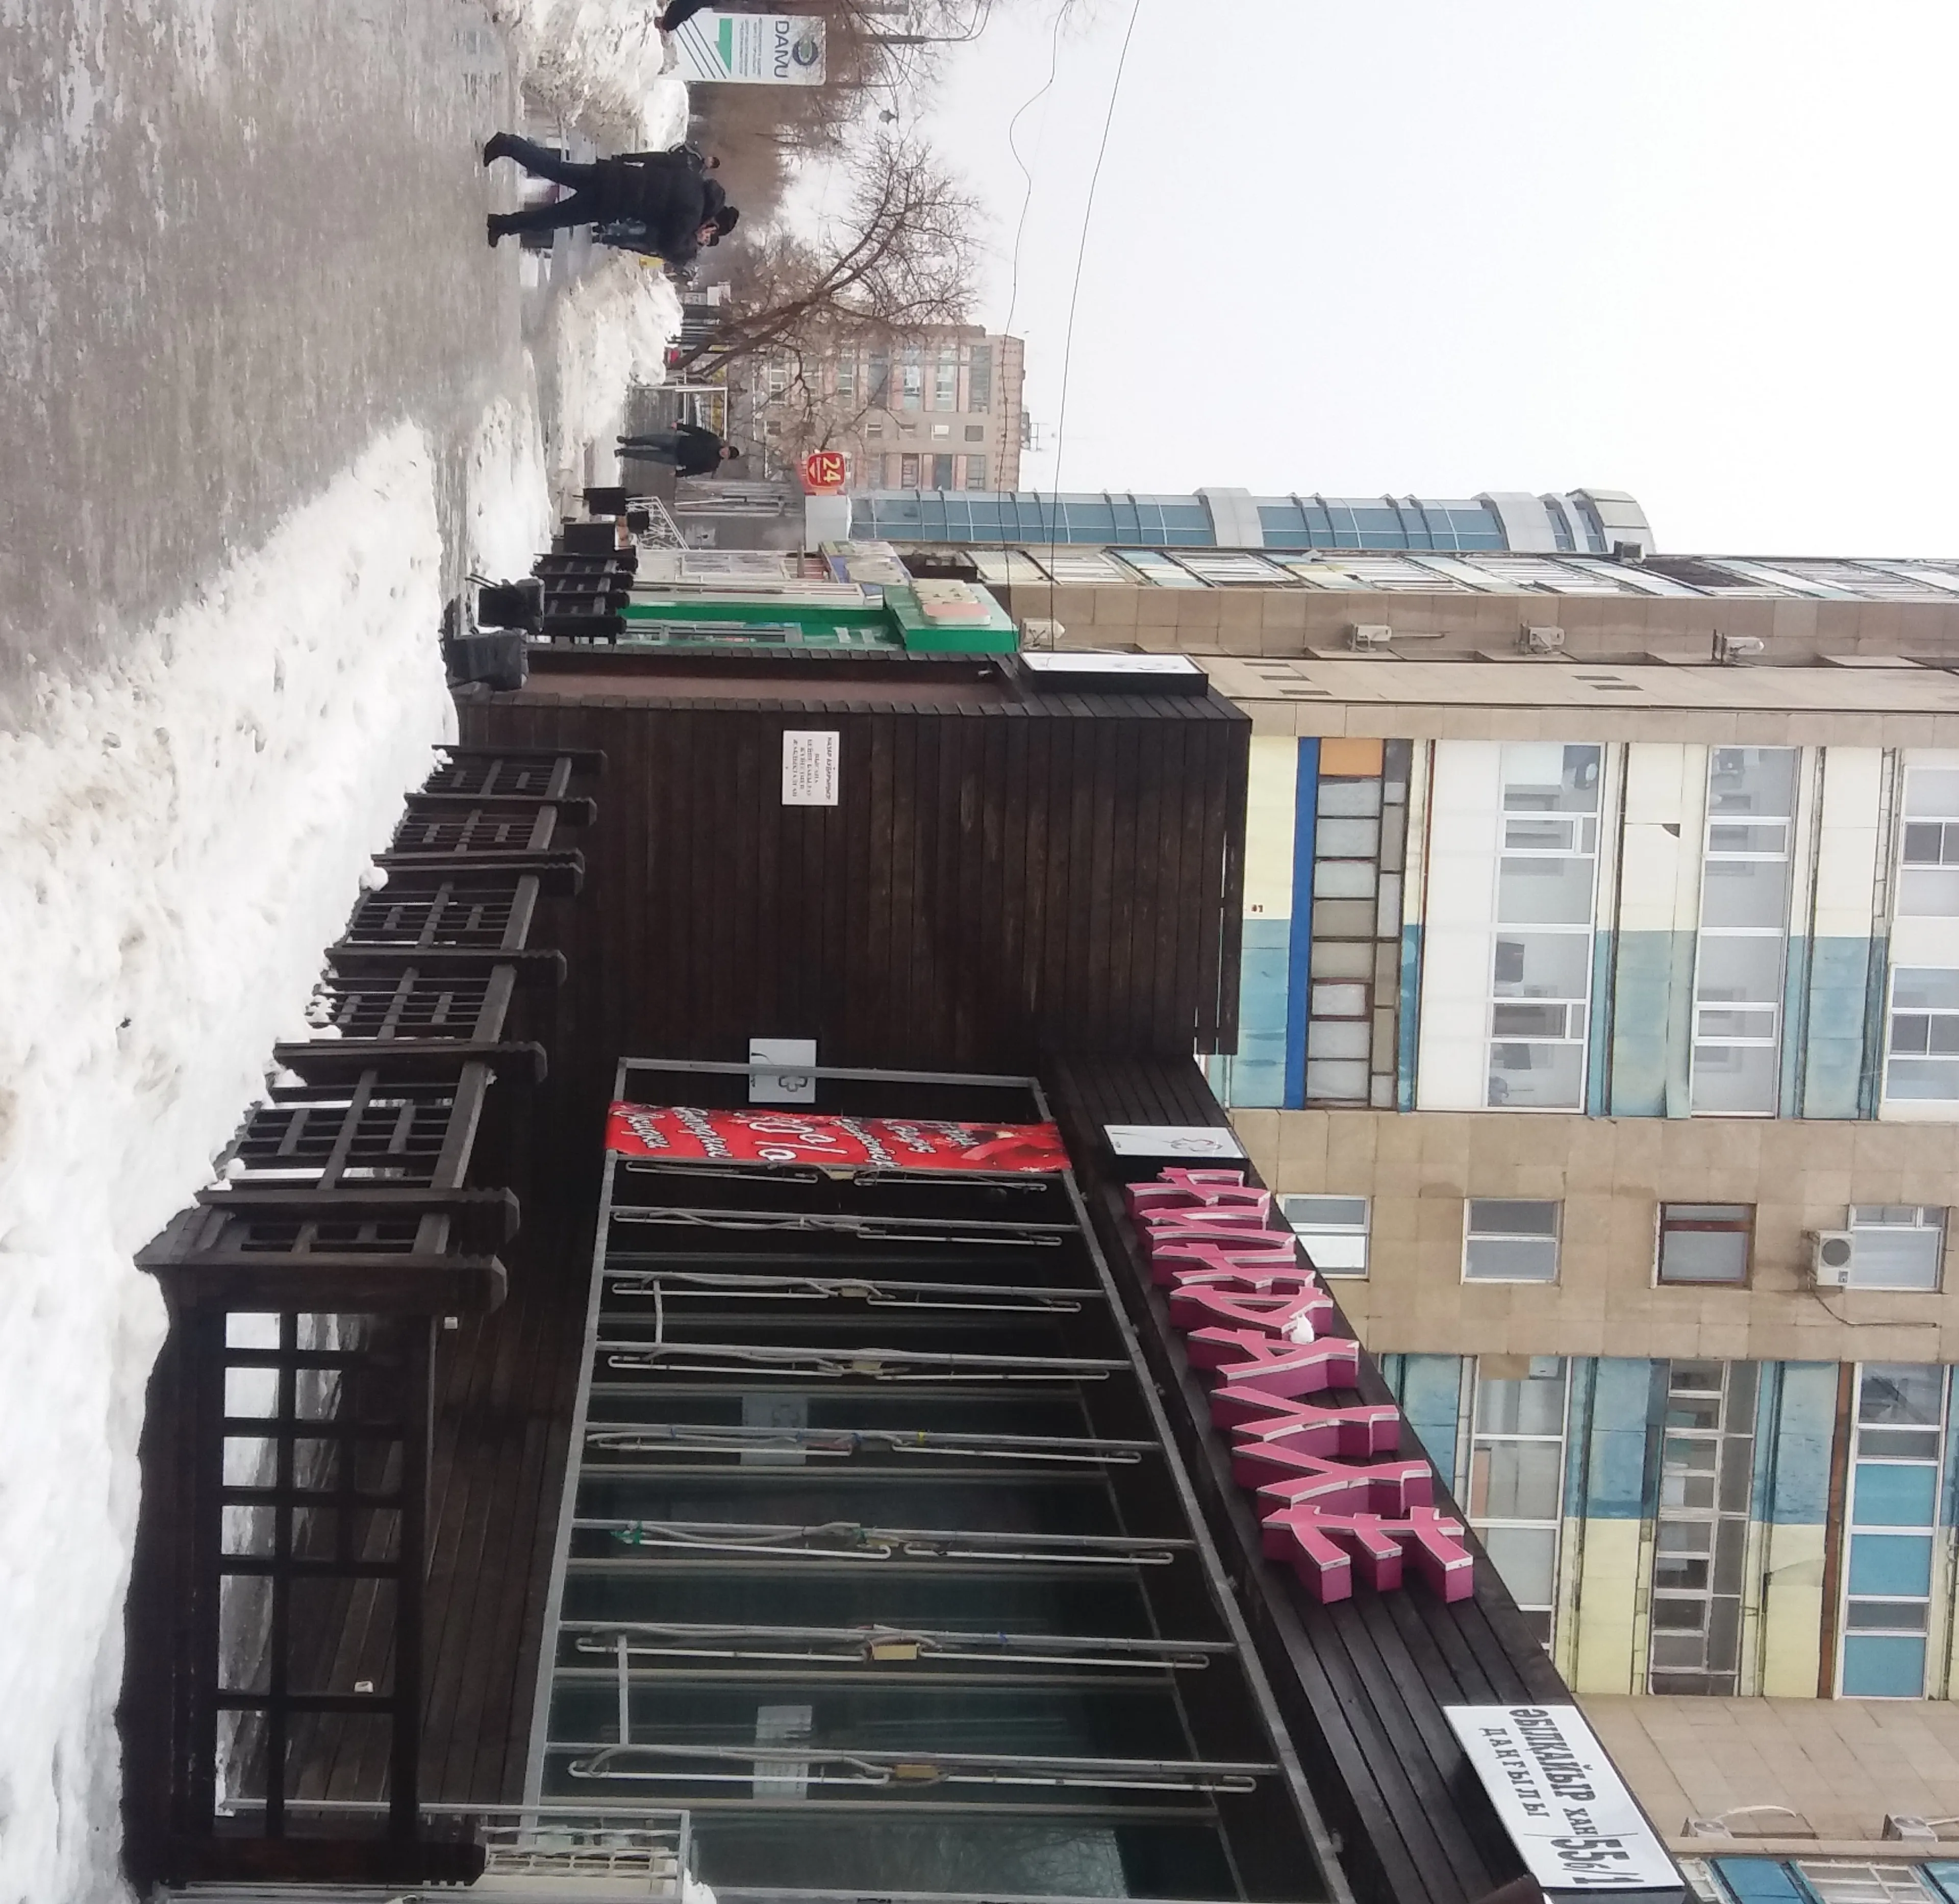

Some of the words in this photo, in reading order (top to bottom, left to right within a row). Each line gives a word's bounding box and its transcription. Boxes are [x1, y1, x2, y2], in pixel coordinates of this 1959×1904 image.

[774, 20, 790, 78] DAMU
[822, 457, 841, 482] 24
[1479, 1728, 1550, 1818] ДАҢҒЫЛЫ
[1509, 1709, 1597, 1801] ӘБІЛҚАЙЫР
